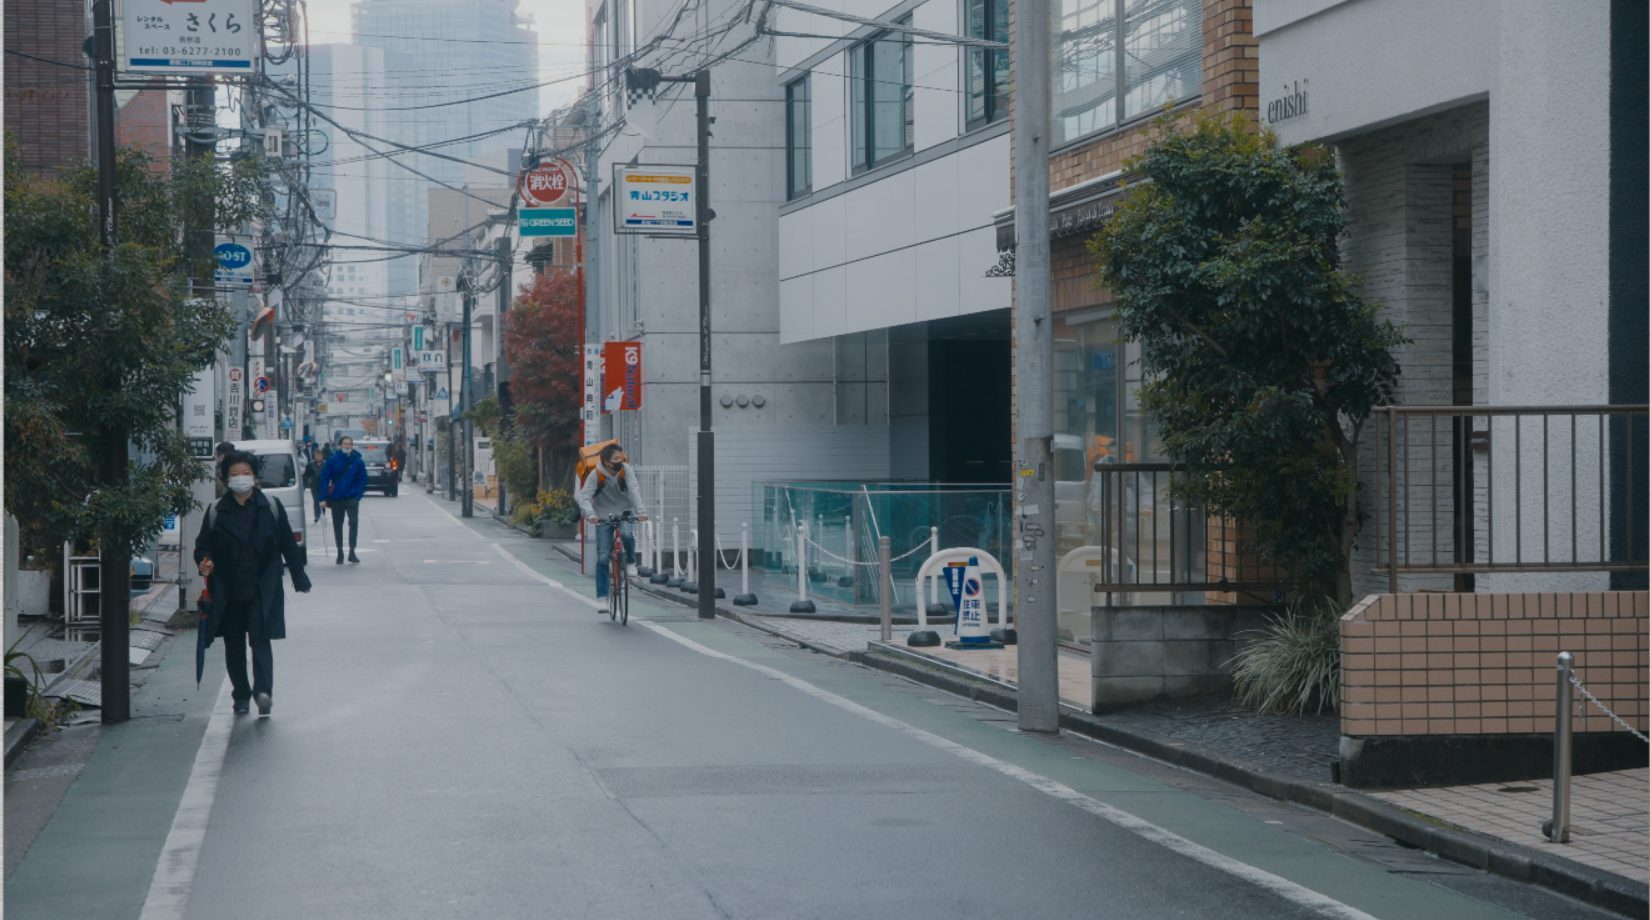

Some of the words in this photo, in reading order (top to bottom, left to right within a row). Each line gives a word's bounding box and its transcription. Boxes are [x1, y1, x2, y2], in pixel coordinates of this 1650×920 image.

[186, 13, 241, 34] さくら
[139, 46, 159, 55] tel:
[163, 46, 241, 56] 03-6277-2100
[1267, 77, 1308, 124] enishi
[529, 174, 565, 191] 消火栓
[528, 218, 554, 227] GREEN
[554, 218, 575, 227] SEED
[625, 346, 638, 365] K9
[625, 365, 638, 409] Natural
[228, 382, 240, 429] 吉川質店
[963, 599, 981, 610] 駐車
[962, 611, 981, 622] 禁止
